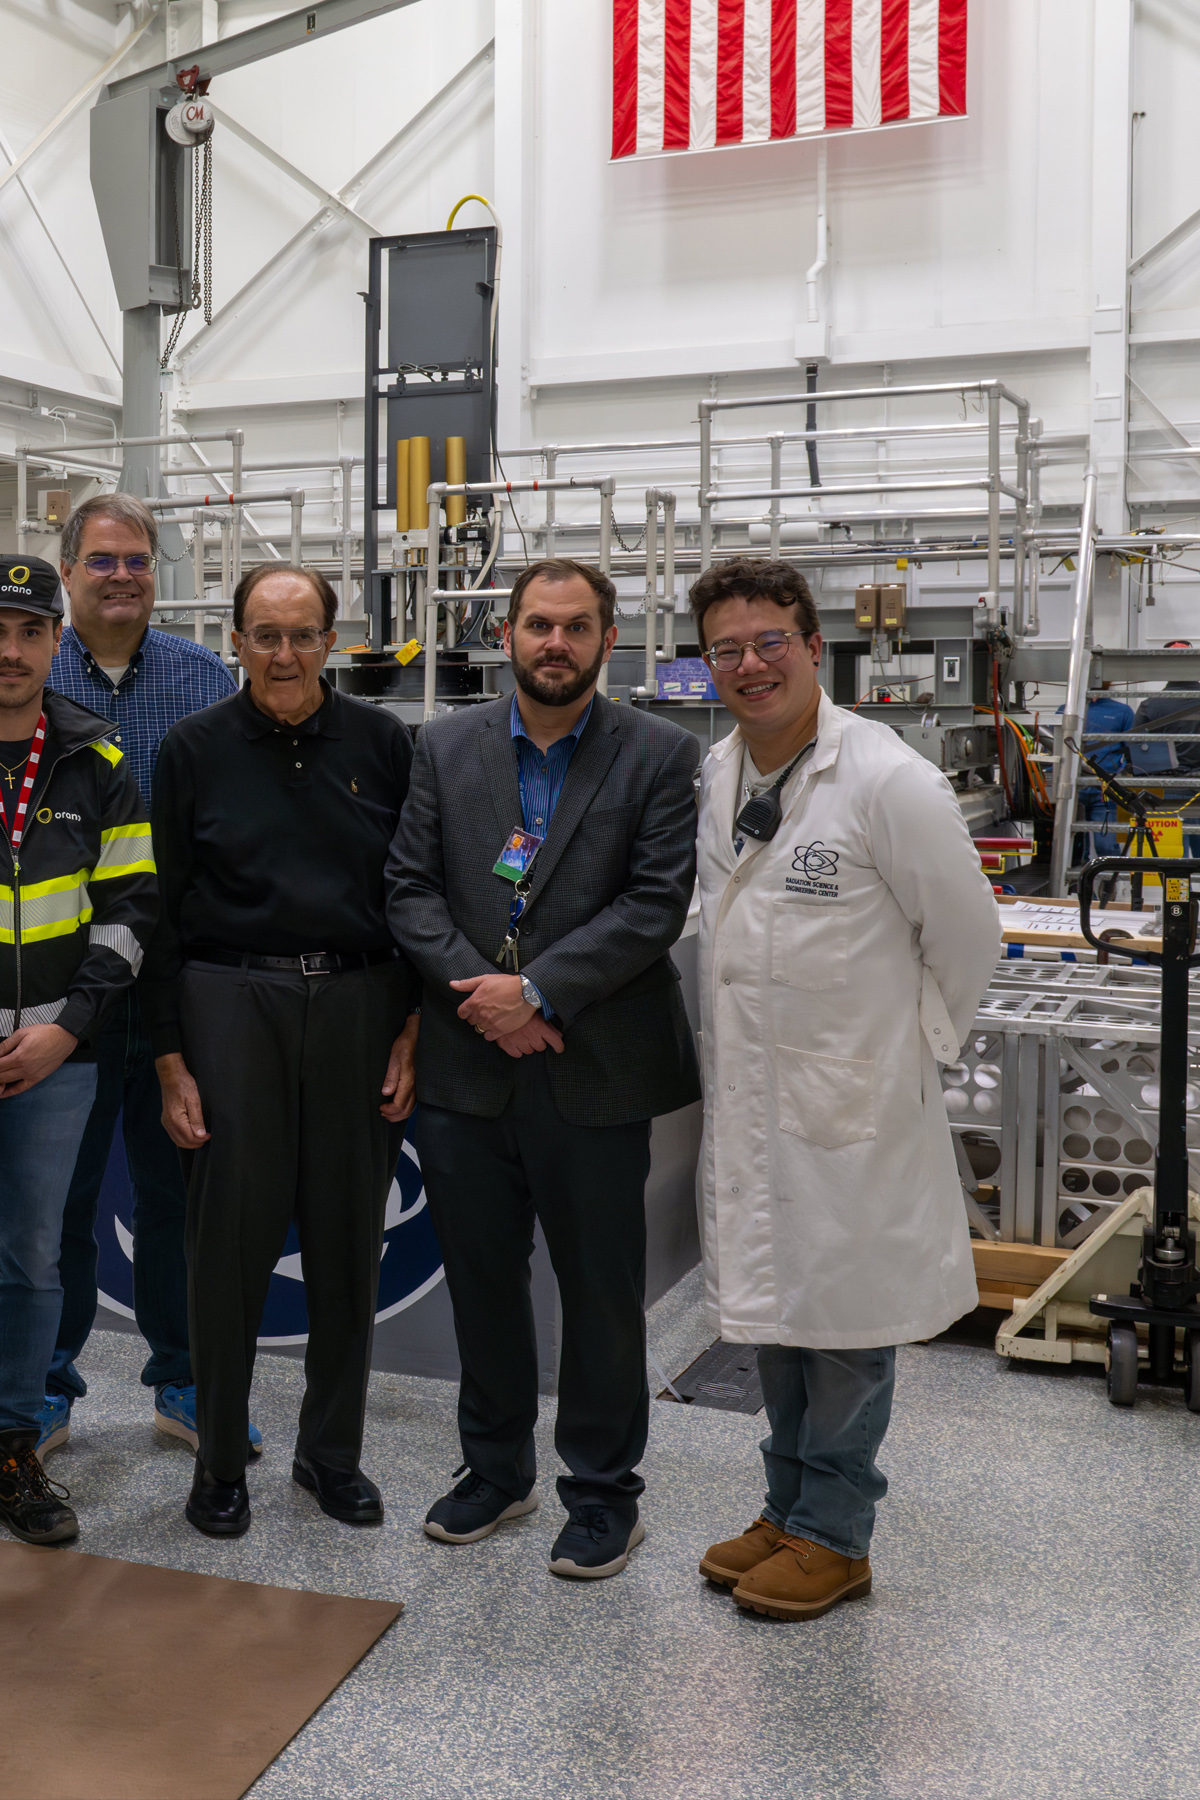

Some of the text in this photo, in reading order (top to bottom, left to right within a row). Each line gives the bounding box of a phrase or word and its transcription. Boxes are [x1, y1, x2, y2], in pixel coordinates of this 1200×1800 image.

[186, 104, 204, 121] CM
[1, 585, 32, 595] orano
[785, 877, 811, 887] RADIATION
[812, 881, 834, 890] SCIENCE
[785, 884, 839, 898] ENGINEERING CENTER
